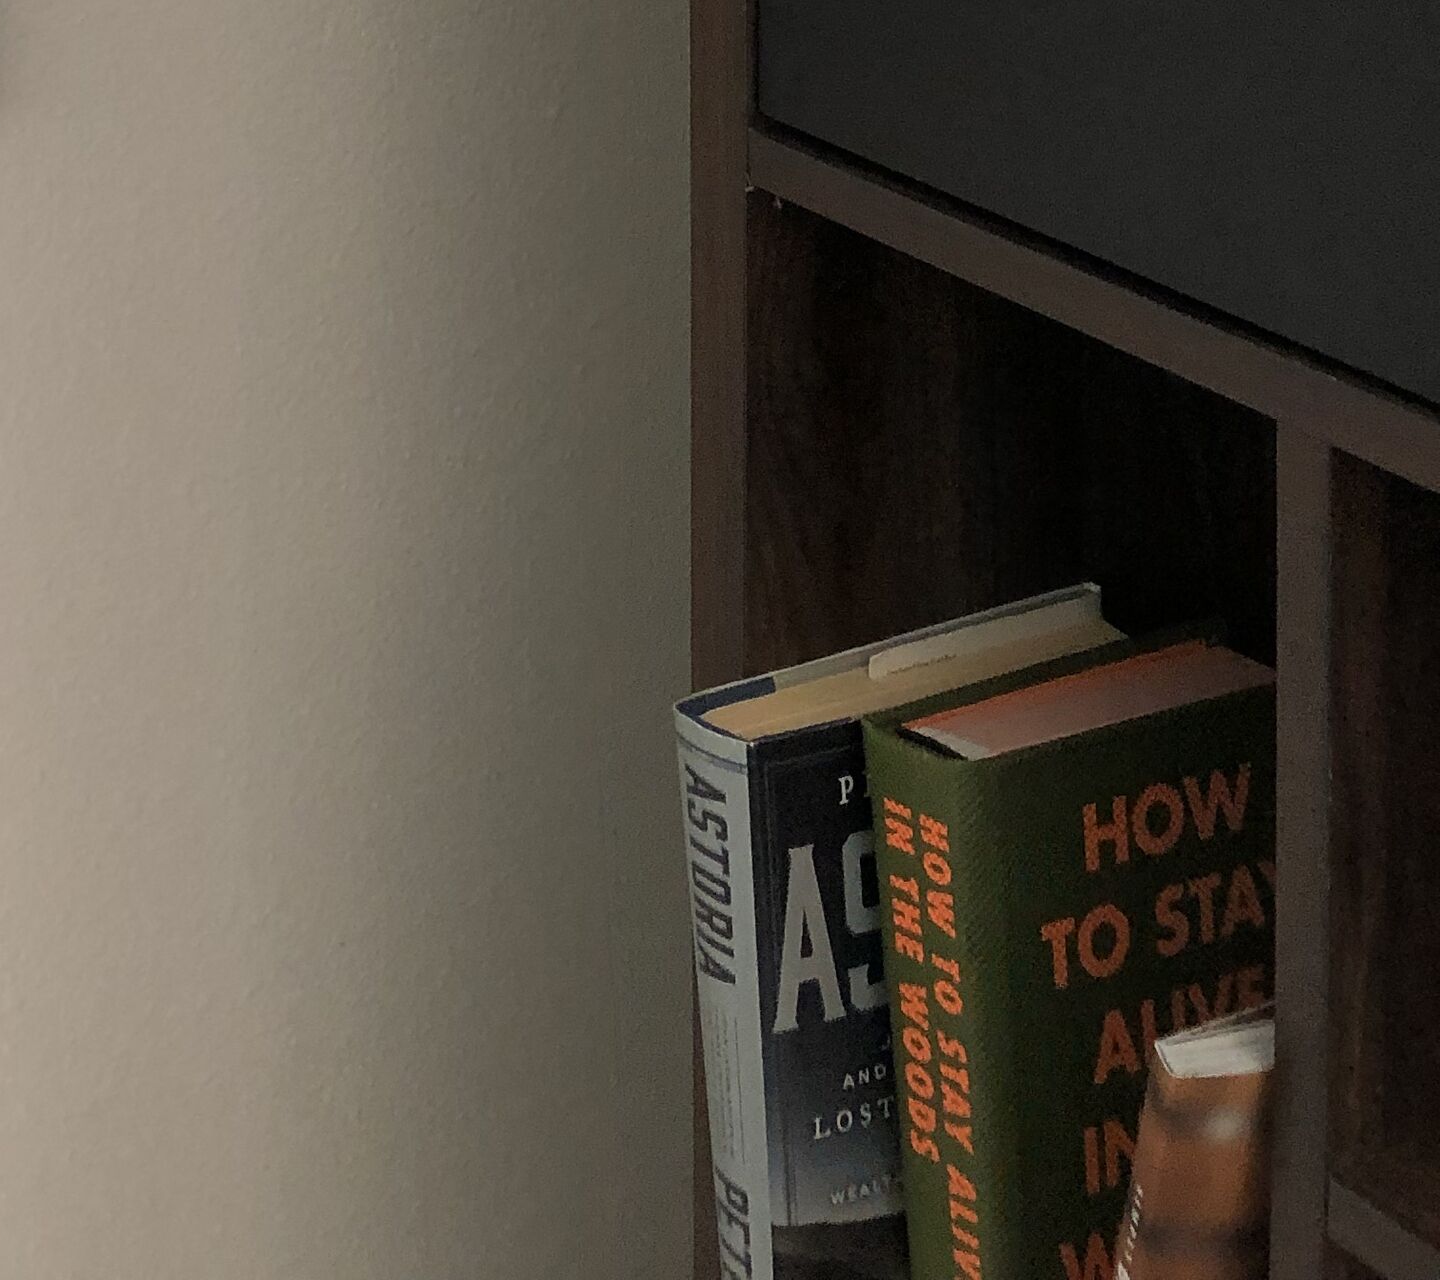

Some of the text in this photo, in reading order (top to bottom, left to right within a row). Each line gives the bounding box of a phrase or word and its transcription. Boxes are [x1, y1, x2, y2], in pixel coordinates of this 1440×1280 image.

[684, 762, 737, 986] ASTORIA
[1080, 760, 1253, 875] HOW
[917, 813, 955, 940] HOW
[882, 794, 942, 1164] IN THE WOODS
[930, 953, 964, 1016] TO
[1038, 902, 1132, 989] TO
[812, 1095, 895, 1140] LOST
[841, 1063, 888, 1091] AND
[936, 1030, 975, 1155] STAY
